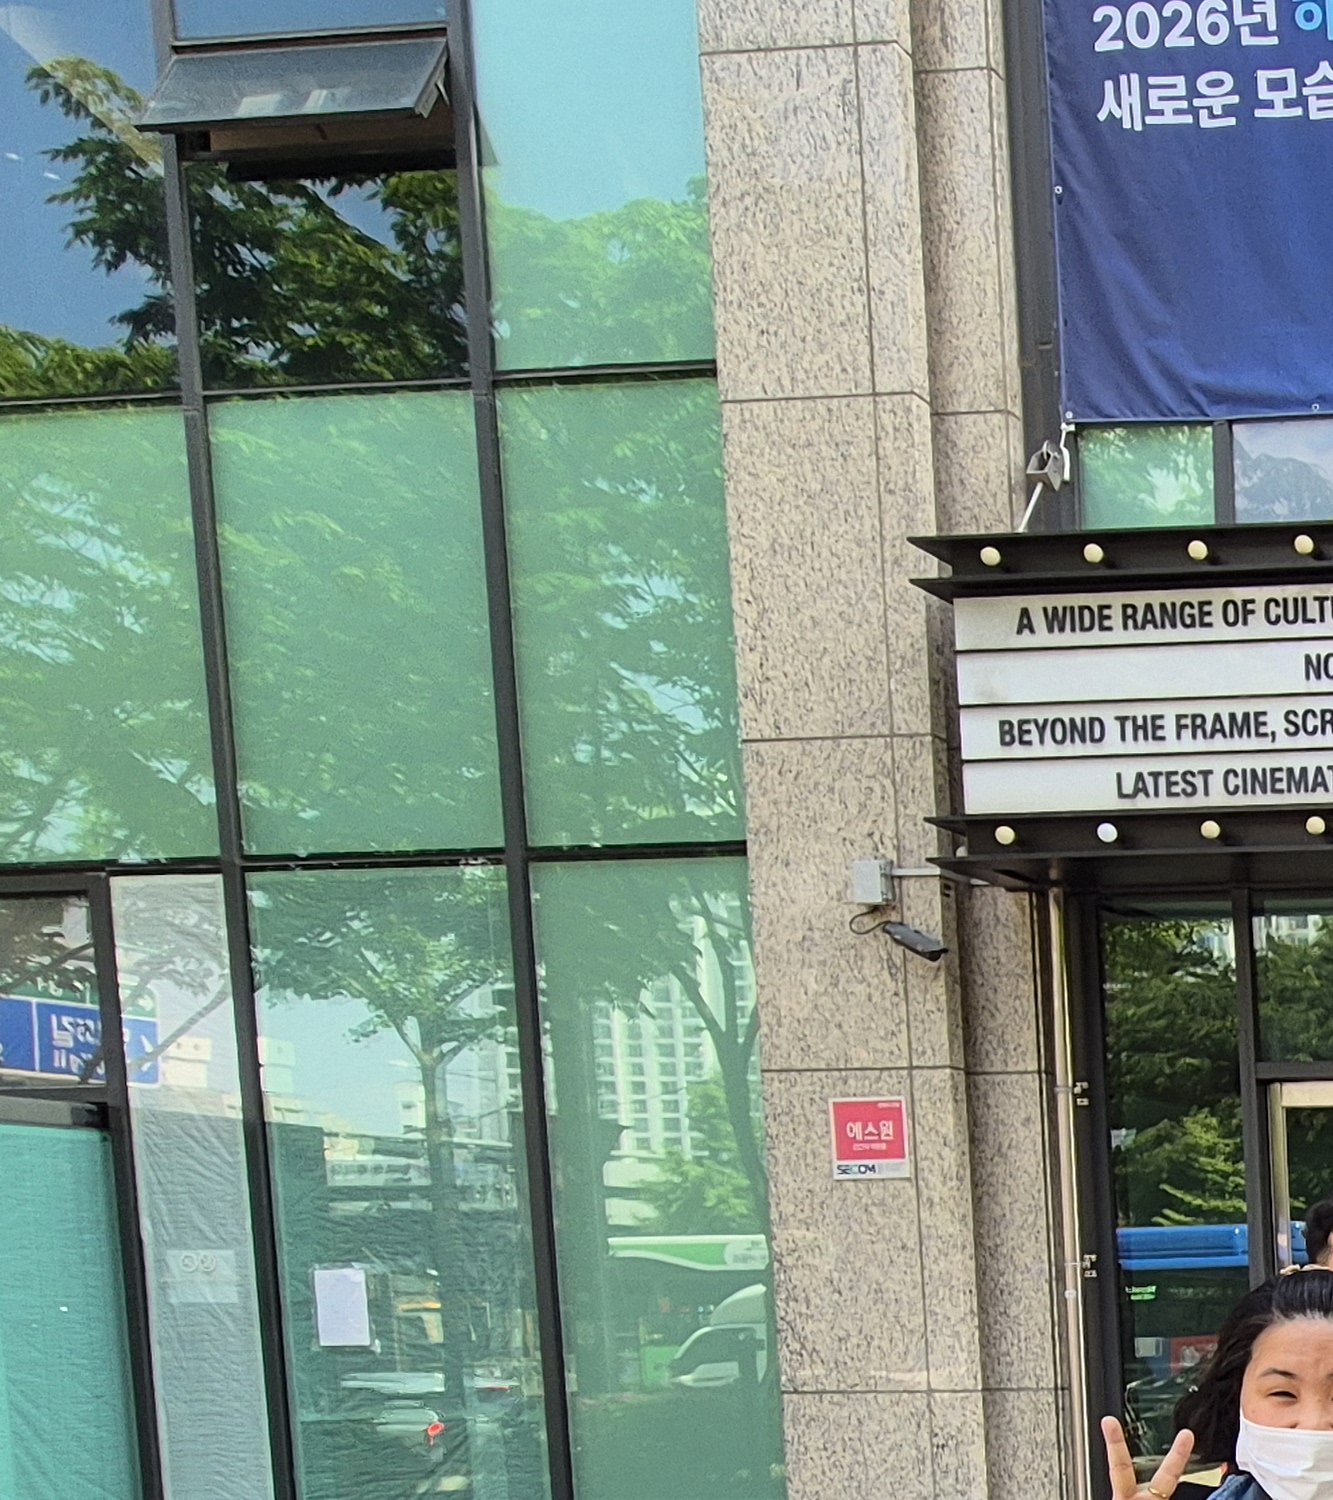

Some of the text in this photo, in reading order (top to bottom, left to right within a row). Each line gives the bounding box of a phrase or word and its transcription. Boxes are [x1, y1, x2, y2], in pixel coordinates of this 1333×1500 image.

[1092, 0, 1279, 52] 2026년
[1096, 70, 1240, 132] 새로운
[1016, 606, 1037, 636] A
[1042, 604, 1114, 634] WIDE
[1121, 599, 1214, 631] RANGE
[1222, 598, 1257, 628] OF
[998, 716, 1106, 747] BEYOND
[1113, 714, 1166, 743] THE
[1175, 711, 1279, 744] FRAME,
[1116, 769, 1214, 800] LATEST
[845, 1119, 895, 1142] 에스원
